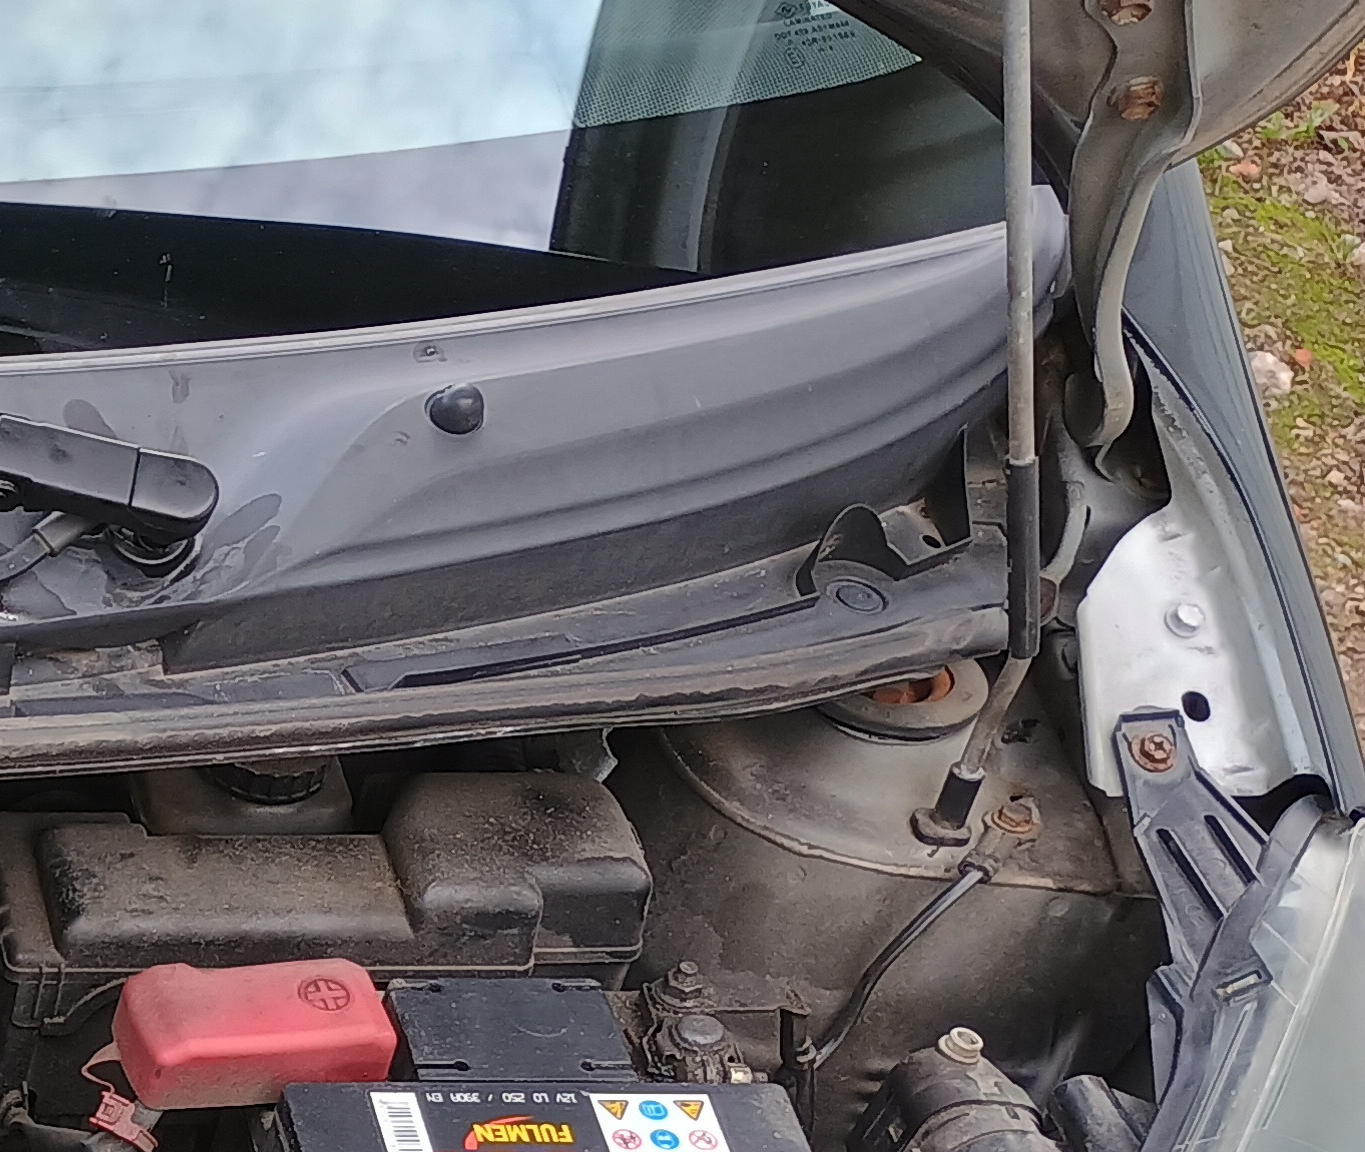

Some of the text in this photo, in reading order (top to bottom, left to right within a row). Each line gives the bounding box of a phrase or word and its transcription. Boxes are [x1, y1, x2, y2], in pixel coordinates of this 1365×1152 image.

[426, 1093, 443, 1102] EN
[450, 1093, 481, 1103] 390A
[502, 1093, 525, 1102] 250
[556, 1093, 578, 1103] 12V
[473, 1124, 574, 1143] FULMEN
